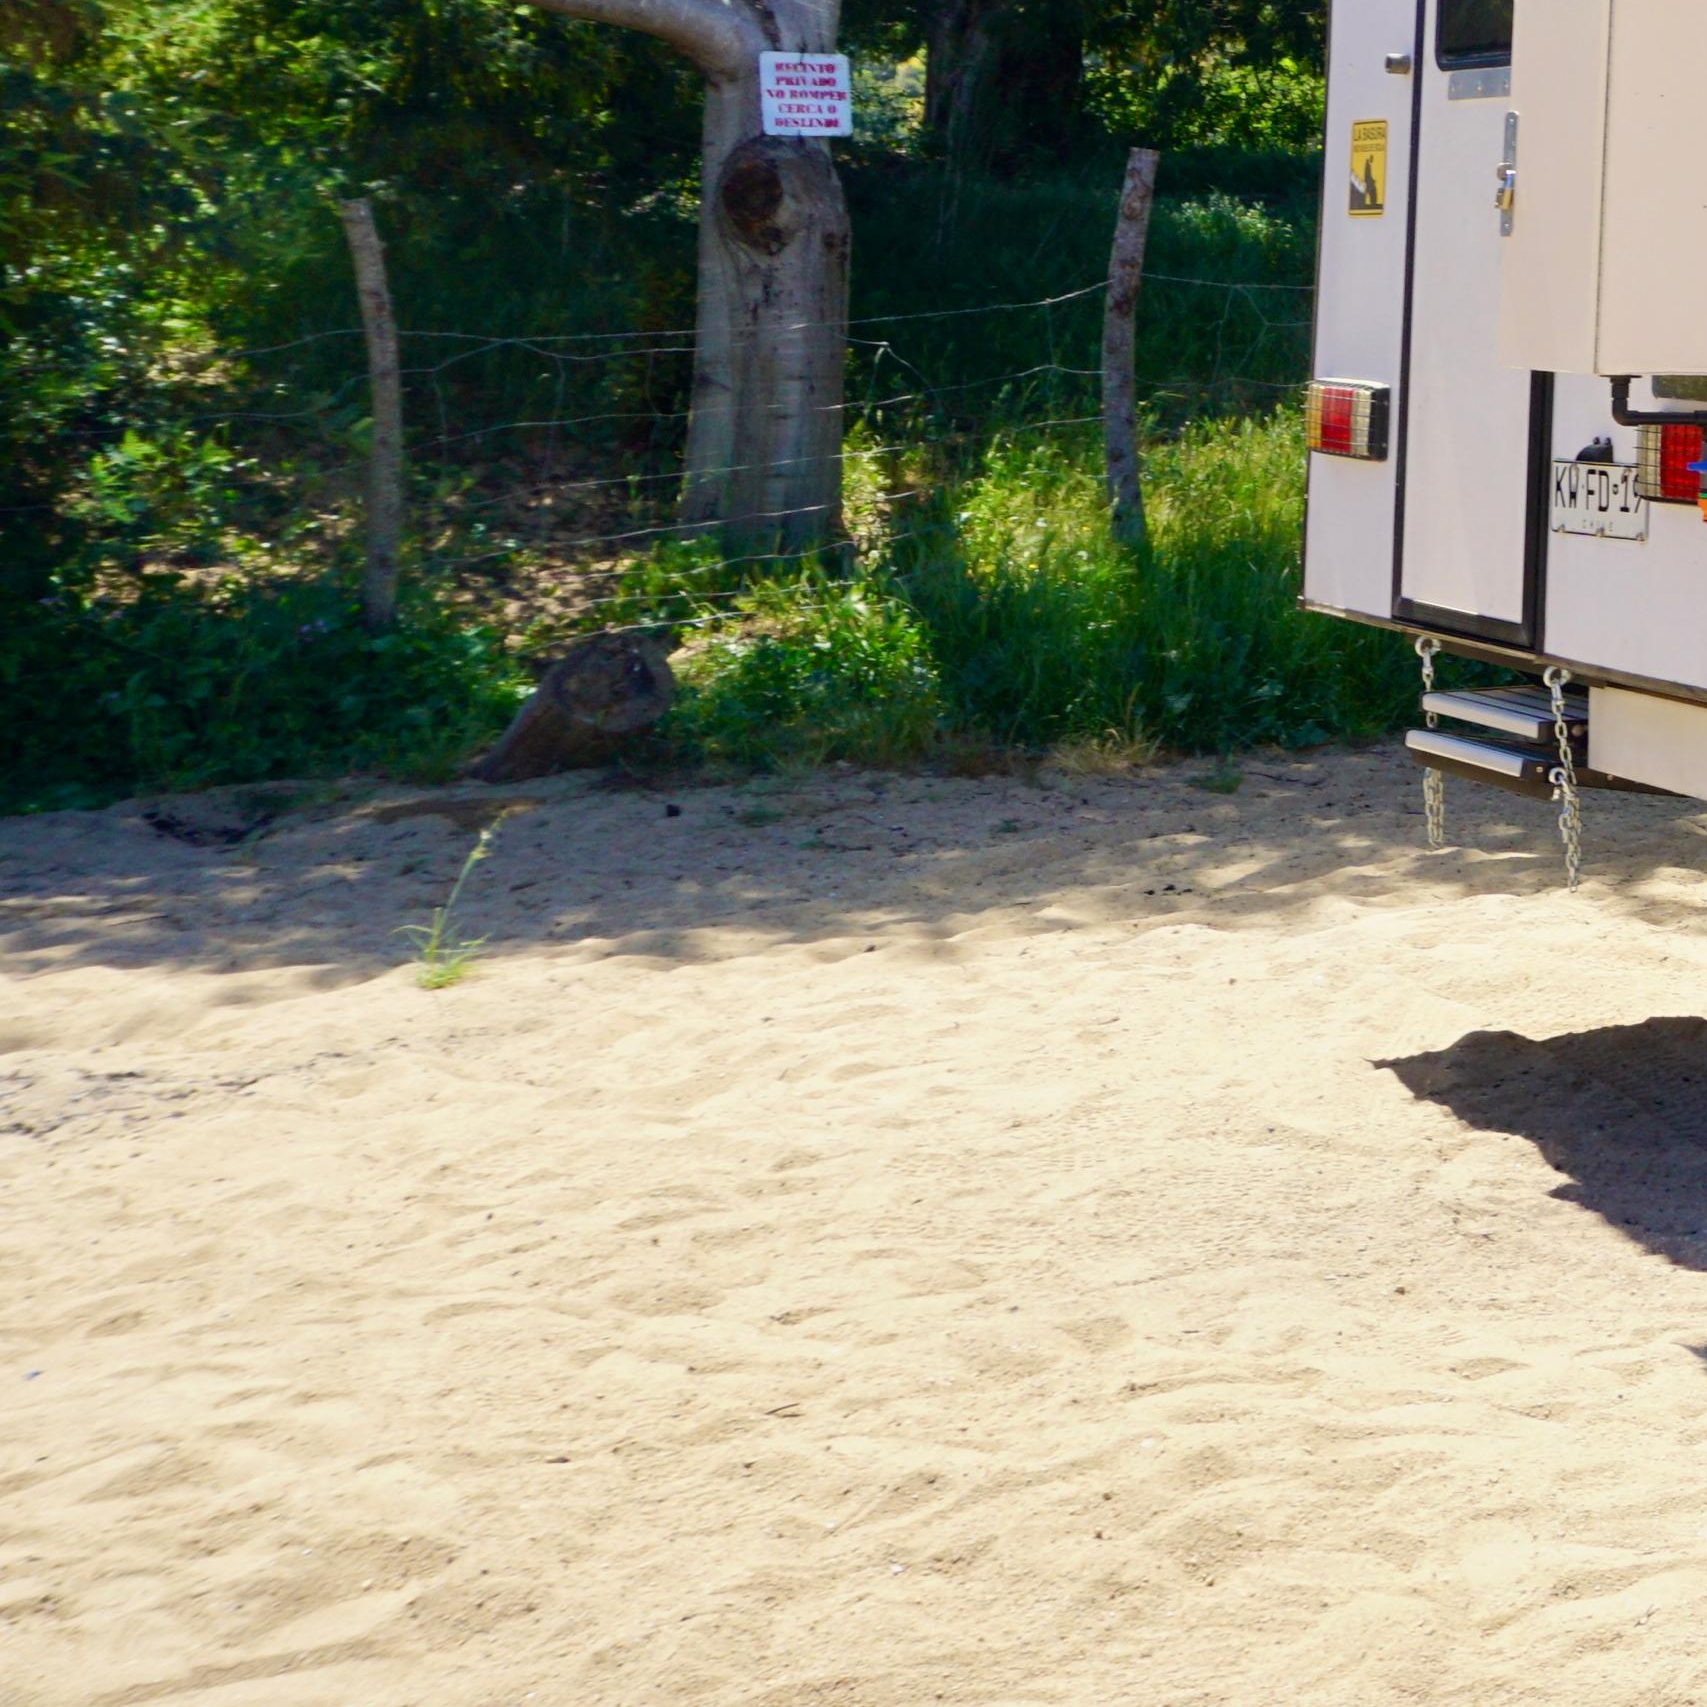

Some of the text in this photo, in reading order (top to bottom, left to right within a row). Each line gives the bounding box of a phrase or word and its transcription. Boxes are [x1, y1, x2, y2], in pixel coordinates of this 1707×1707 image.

[775, 62, 836, 74] RECINTO
[775, 76, 837, 87] PRIVADO
[766, 89, 785, 99] NO
[778, 103, 837, 114] CERCA O
